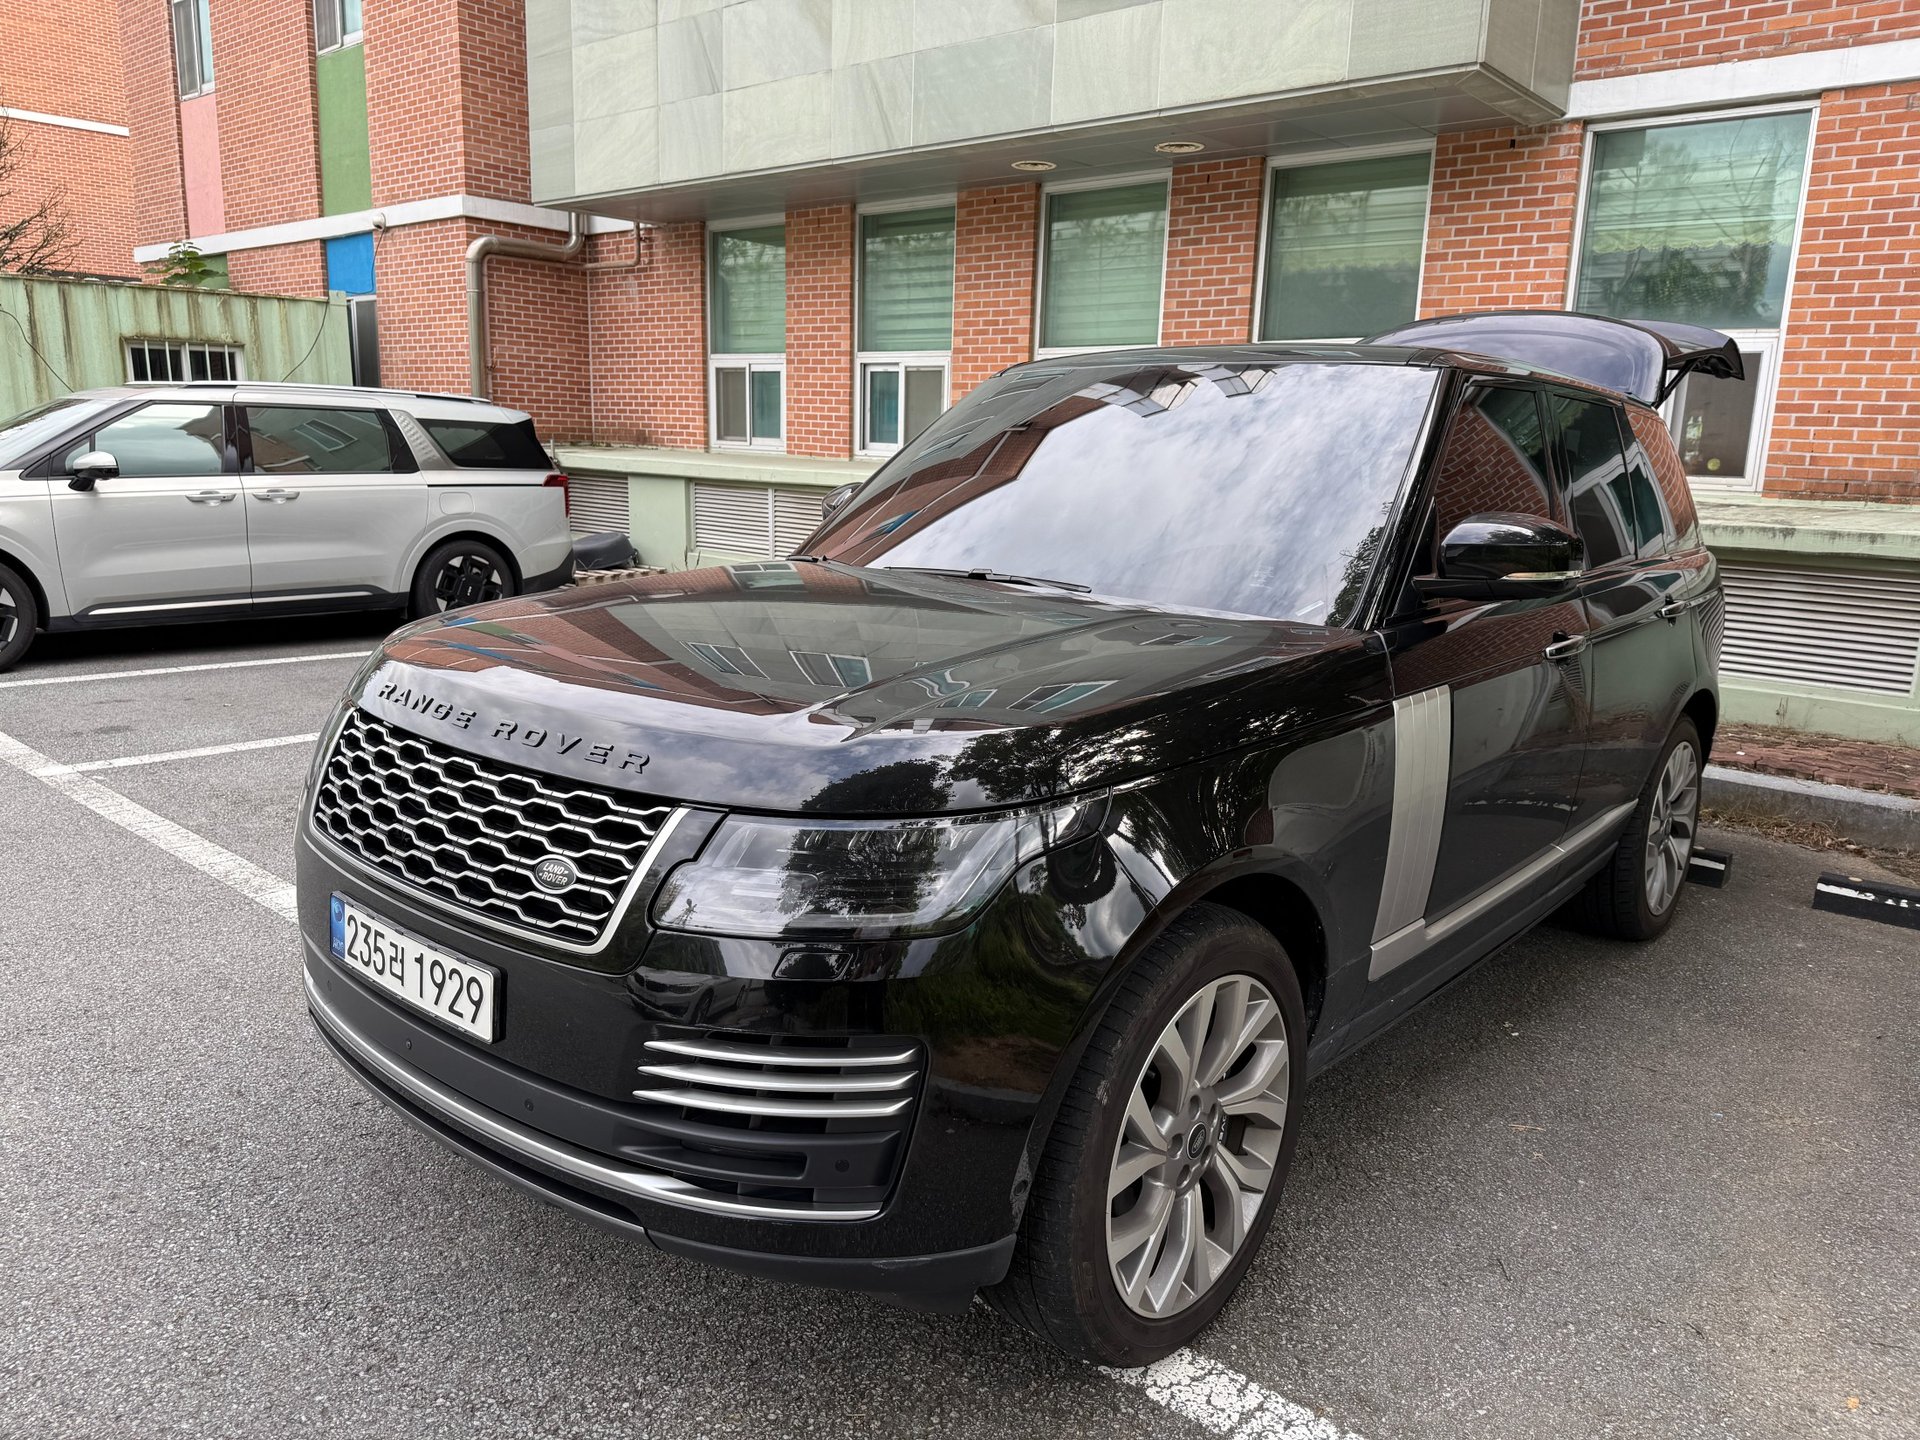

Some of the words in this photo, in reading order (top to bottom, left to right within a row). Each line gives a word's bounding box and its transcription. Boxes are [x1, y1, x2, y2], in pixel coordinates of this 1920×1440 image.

[378, 682, 477, 730] RANGE
[491, 718, 651, 775] ROVER
[541, 871, 568, 886] ROVER
[542, 862, 565, 875] LAND
[414, 952, 484, 1024] 1929
